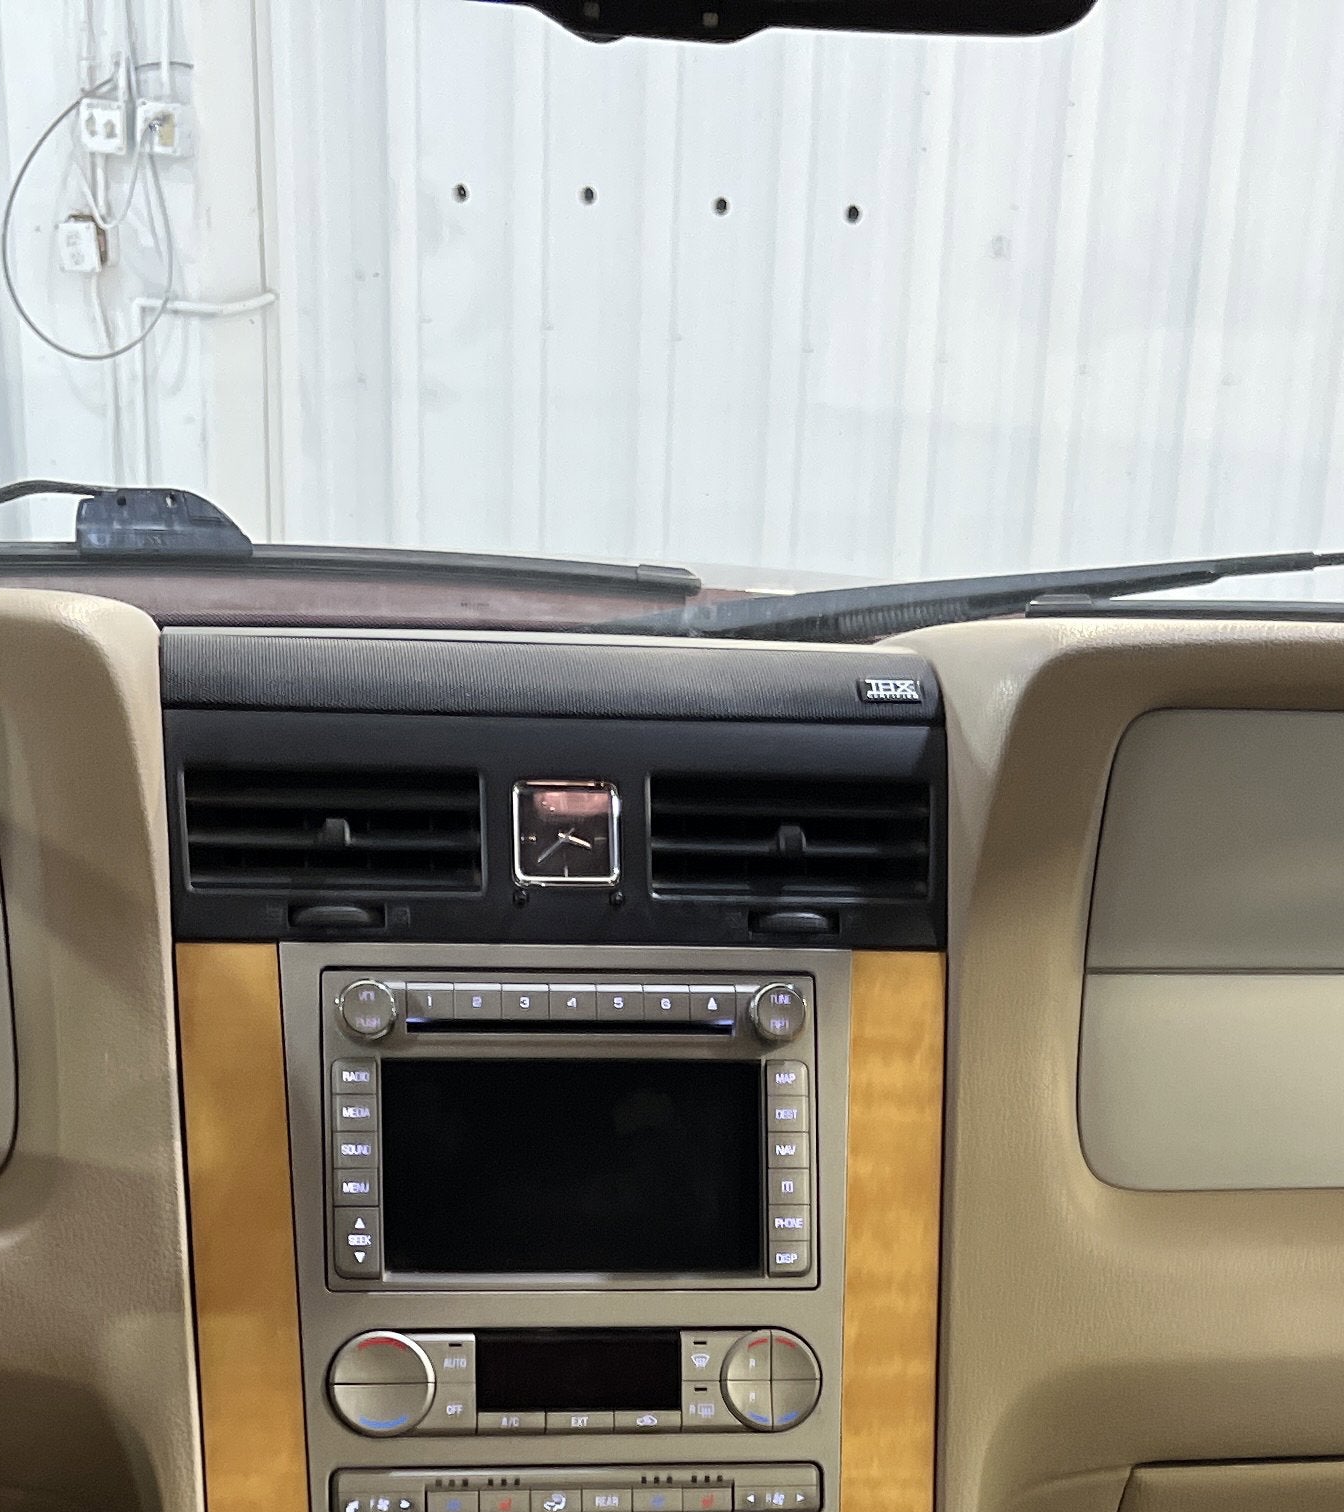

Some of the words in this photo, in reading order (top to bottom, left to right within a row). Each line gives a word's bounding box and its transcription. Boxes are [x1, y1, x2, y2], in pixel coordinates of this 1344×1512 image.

[519, 996, 529, 1008] 3
[567, 997, 577, 1008] 4
[613, 997, 623, 1008] 5
[342, 1071, 370, 1082] RADIO
[775, 1073, 796, 1084] MAP
[342, 1106, 370, 1118] MEDIA
[341, 1144, 371, 1155] SOUND
[775, 1145, 796, 1155] NAV
[342, 1182, 370, 1194] MENU
[774, 1218, 803, 1229] PHONE
[348, 1234, 371, 1246] SEEK
[775, 1253, 798, 1264] DISP
[443, 1357, 467, 1369] AUTO
[446, 1404, 464, 1415] OFF
[501, 1416, 520, 1428] A/C
[571, 1416, 589, 1427] EXT
[595, 1496, 619, 1507] REAR
